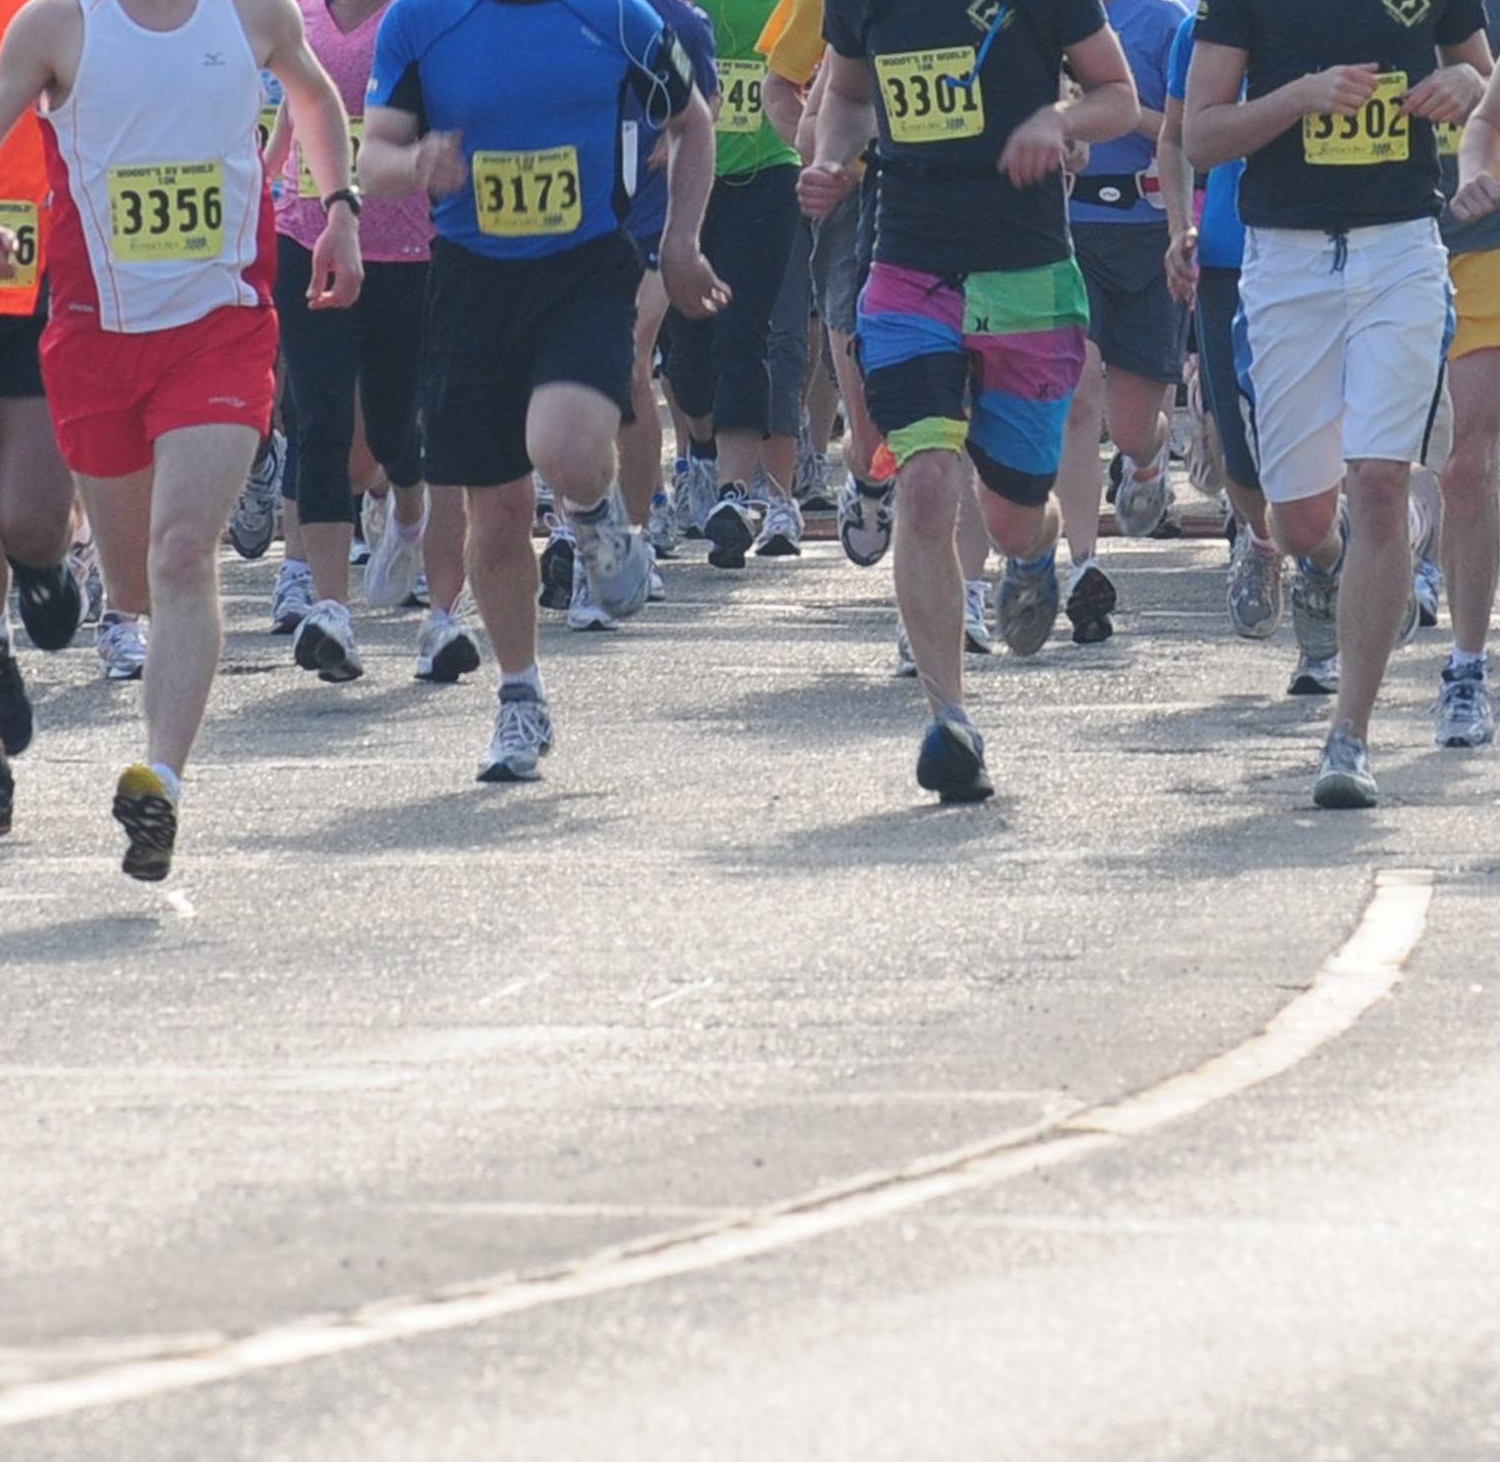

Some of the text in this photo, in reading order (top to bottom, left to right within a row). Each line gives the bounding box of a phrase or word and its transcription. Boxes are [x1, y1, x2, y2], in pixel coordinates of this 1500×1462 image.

[718, 78, 762, 114] 49
[886, 71, 978, 119] 3301
[120, 186, 222, 235] 3356
[484, 170, 577, 214] 3173
